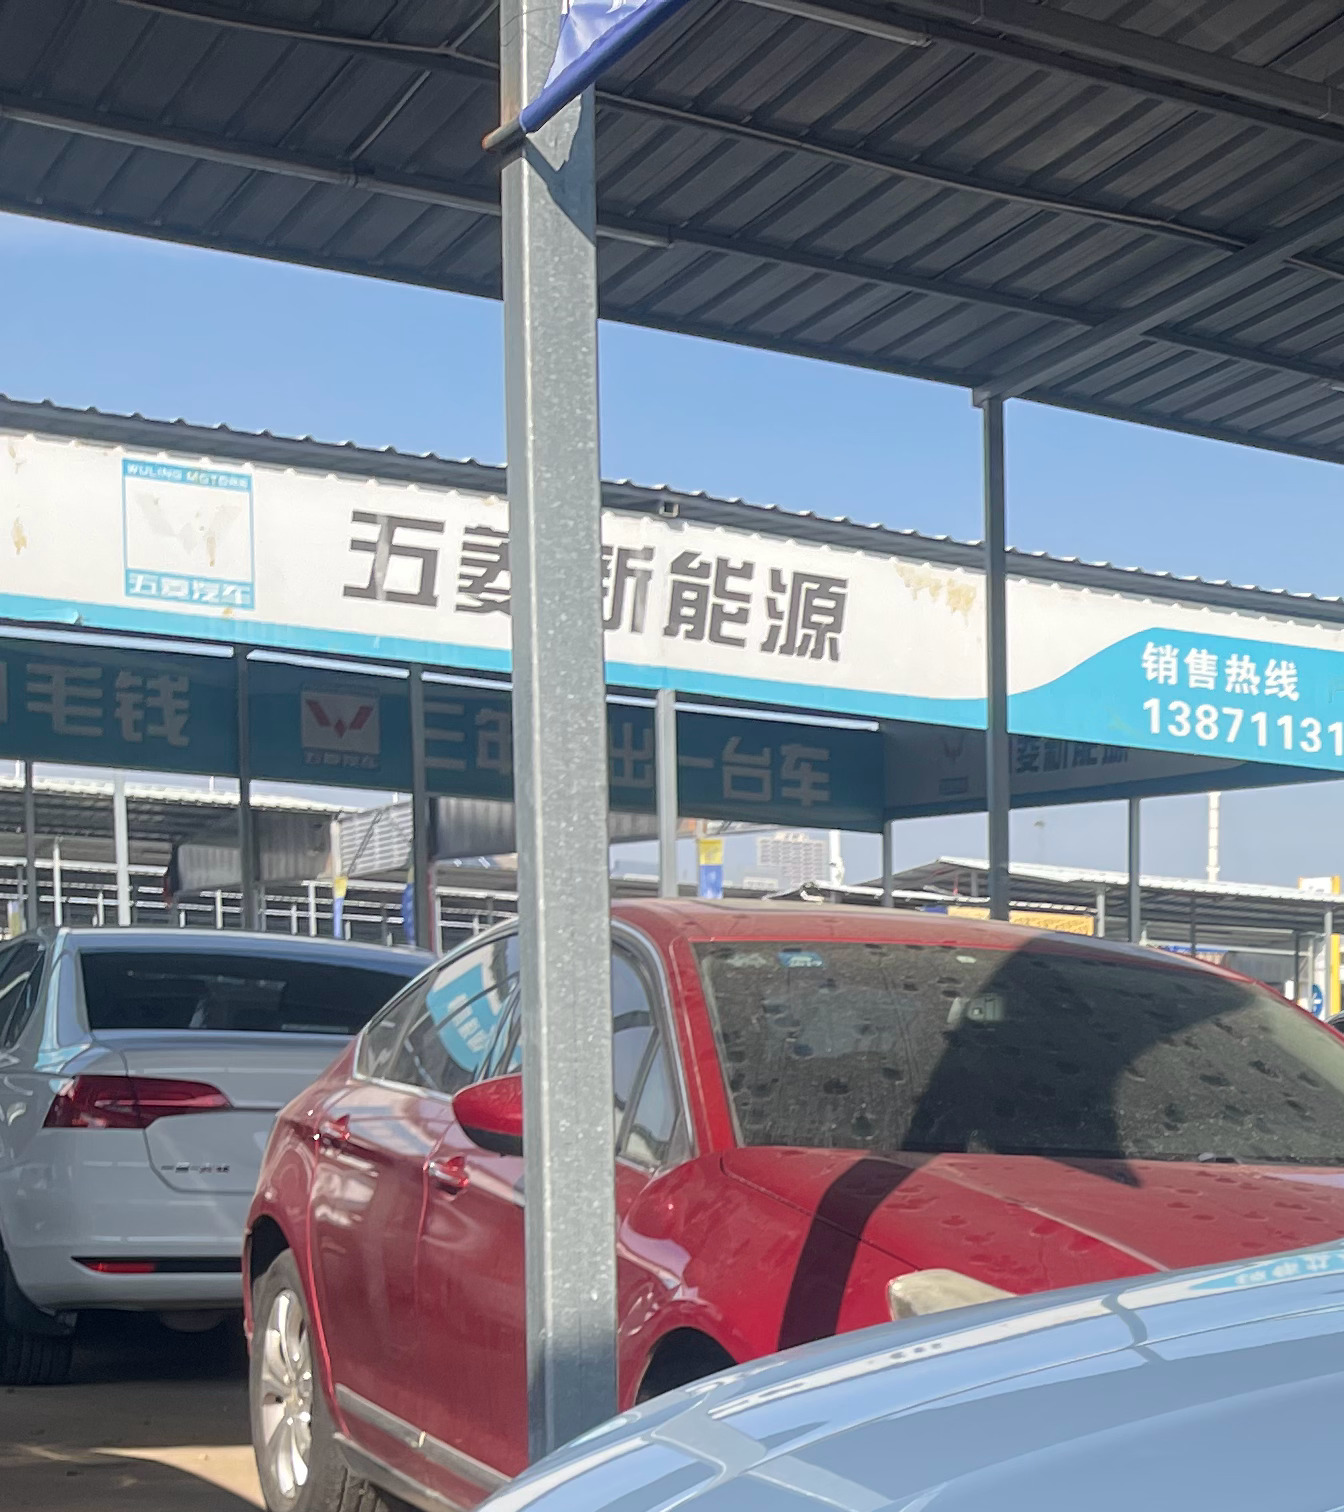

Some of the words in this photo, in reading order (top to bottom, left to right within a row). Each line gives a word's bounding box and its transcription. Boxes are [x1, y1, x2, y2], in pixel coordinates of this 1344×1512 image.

[0, 661, 190, 747] 毛钱
[1141, 641, 1299, 702] 销售热线
[425, 700, 832, 806] 三年出一台车
